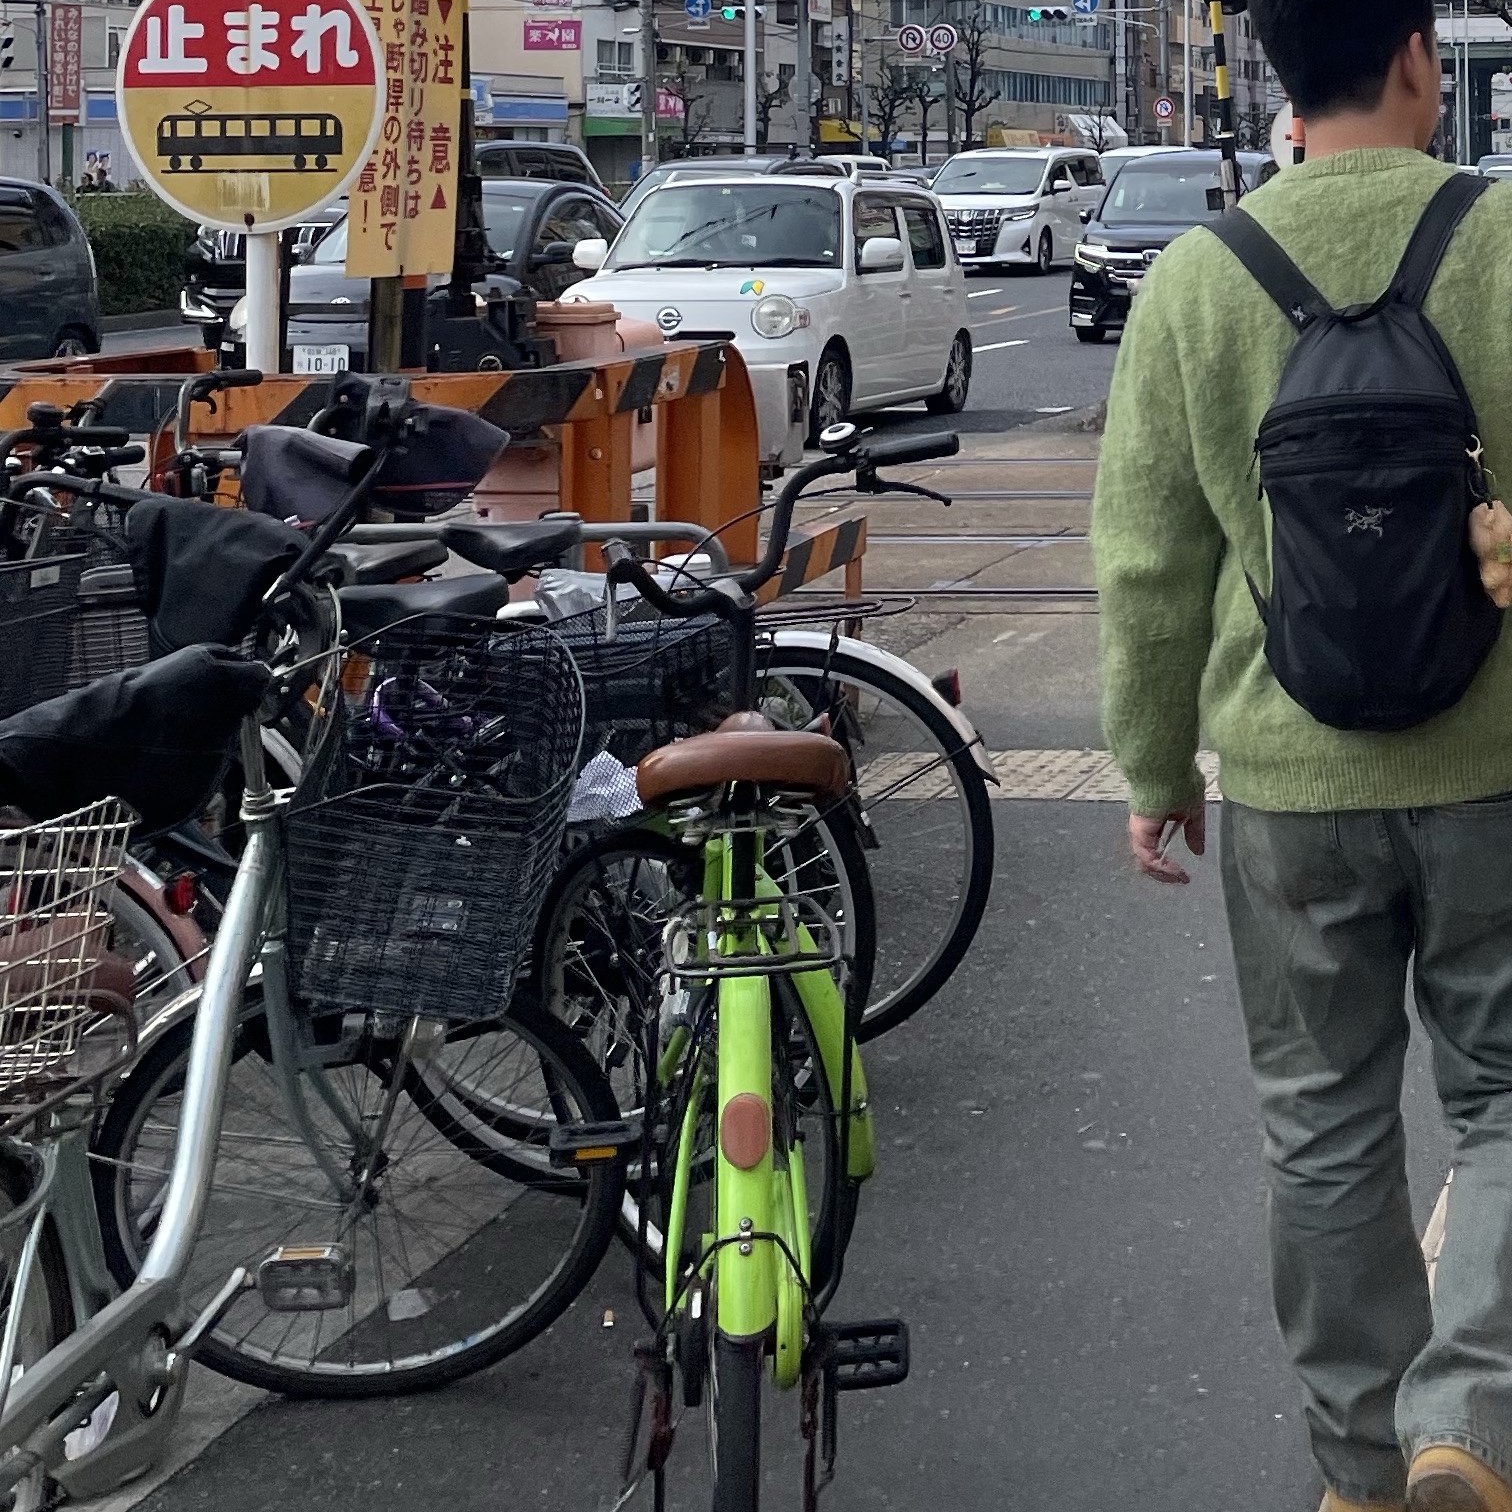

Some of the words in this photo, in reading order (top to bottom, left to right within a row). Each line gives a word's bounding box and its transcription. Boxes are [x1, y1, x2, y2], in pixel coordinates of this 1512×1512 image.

[137, 3, 359, 75] 止まれ
[934, 32, 950, 44] 40
[429, 34, 455, 176] 注意
